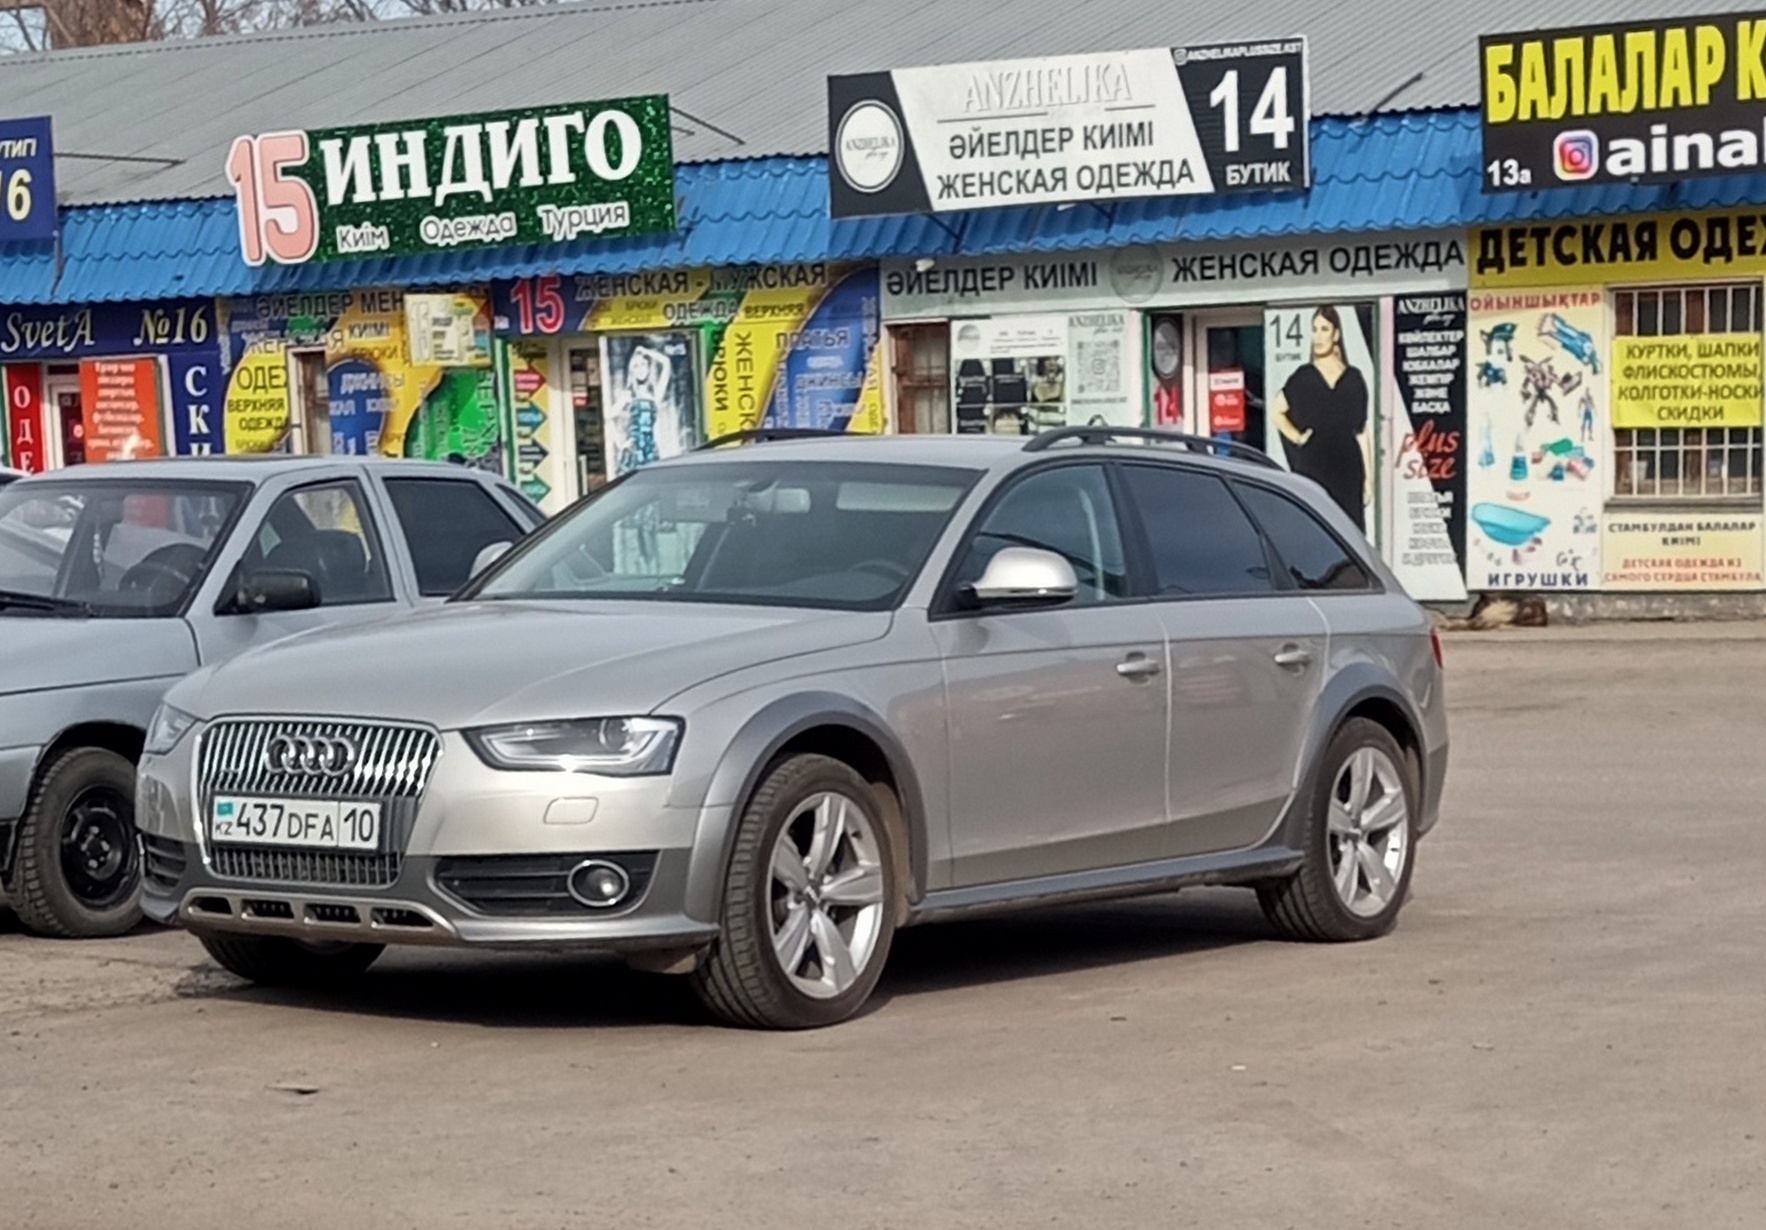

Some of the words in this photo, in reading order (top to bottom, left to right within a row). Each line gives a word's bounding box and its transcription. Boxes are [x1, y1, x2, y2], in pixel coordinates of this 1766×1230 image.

[964, 62, 1132, 114] ANZHELIKA
[1486, 26, 1726, 123] БАЛАЛАР
[1208, 66, 1295, 153] 14
[319, 110, 642, 206] ИНДИГО
[949, 125, 1073, 160] ӘЙЕЛДЕР
[1082, 121, 1154, 149] КИІМІ
[1606, 116, 1766, 176] aina
[937, 167, 1069, 200] ЖЕНСКАЯ
[1076, 158, 1194, 193] ОДЕЖДА
[1226, 160, 1291, 186] БУТИК
[226, 129, 319, 266] 15
[421, 212, 516, 247] Одежда
[538, 200, 629, 239] Турция
[1477, 220, 1658, 275] ДЕТСКАЯ
[575, 270, 688, 300] ЖЕНСКАЯ
[886, 265, 1015, 298] ӘЙЕЛДЕР
[1023, 261, 1098, 290] КИІМІ
[1172, 249, 1319, 283] ЖЕНСКАЯ
[1329, 240, 1465, 277] ОДЕЖДА
[510, 273, 564, 334] 15
[1, 309, 95, 353] SvetA
[133, 306, 208, 347] №16
[1270, 314, 1303, 348] 14
[1697, 342, 1759, 358] ШАПКИ
[237, 365, 287, 394] ОДЕ
[1657, 406, 1724, 421] СКИДКИ
[1396, 419, 1460, 468] plus
[1403, 453, 1457, 479] size
[1608, 522, 1693, 533] СТАМБУЛДАН
[1697, 521, 1756, 532] БАЛАЛАР
[1488, 571, 1588, 587] ИГРУШКИ
[215, 821, 233, 835] KZ
[236, 802, 285, 837] 437
[287, 812, 334, 841] DFA
[344, 808, 374, 842] 10
